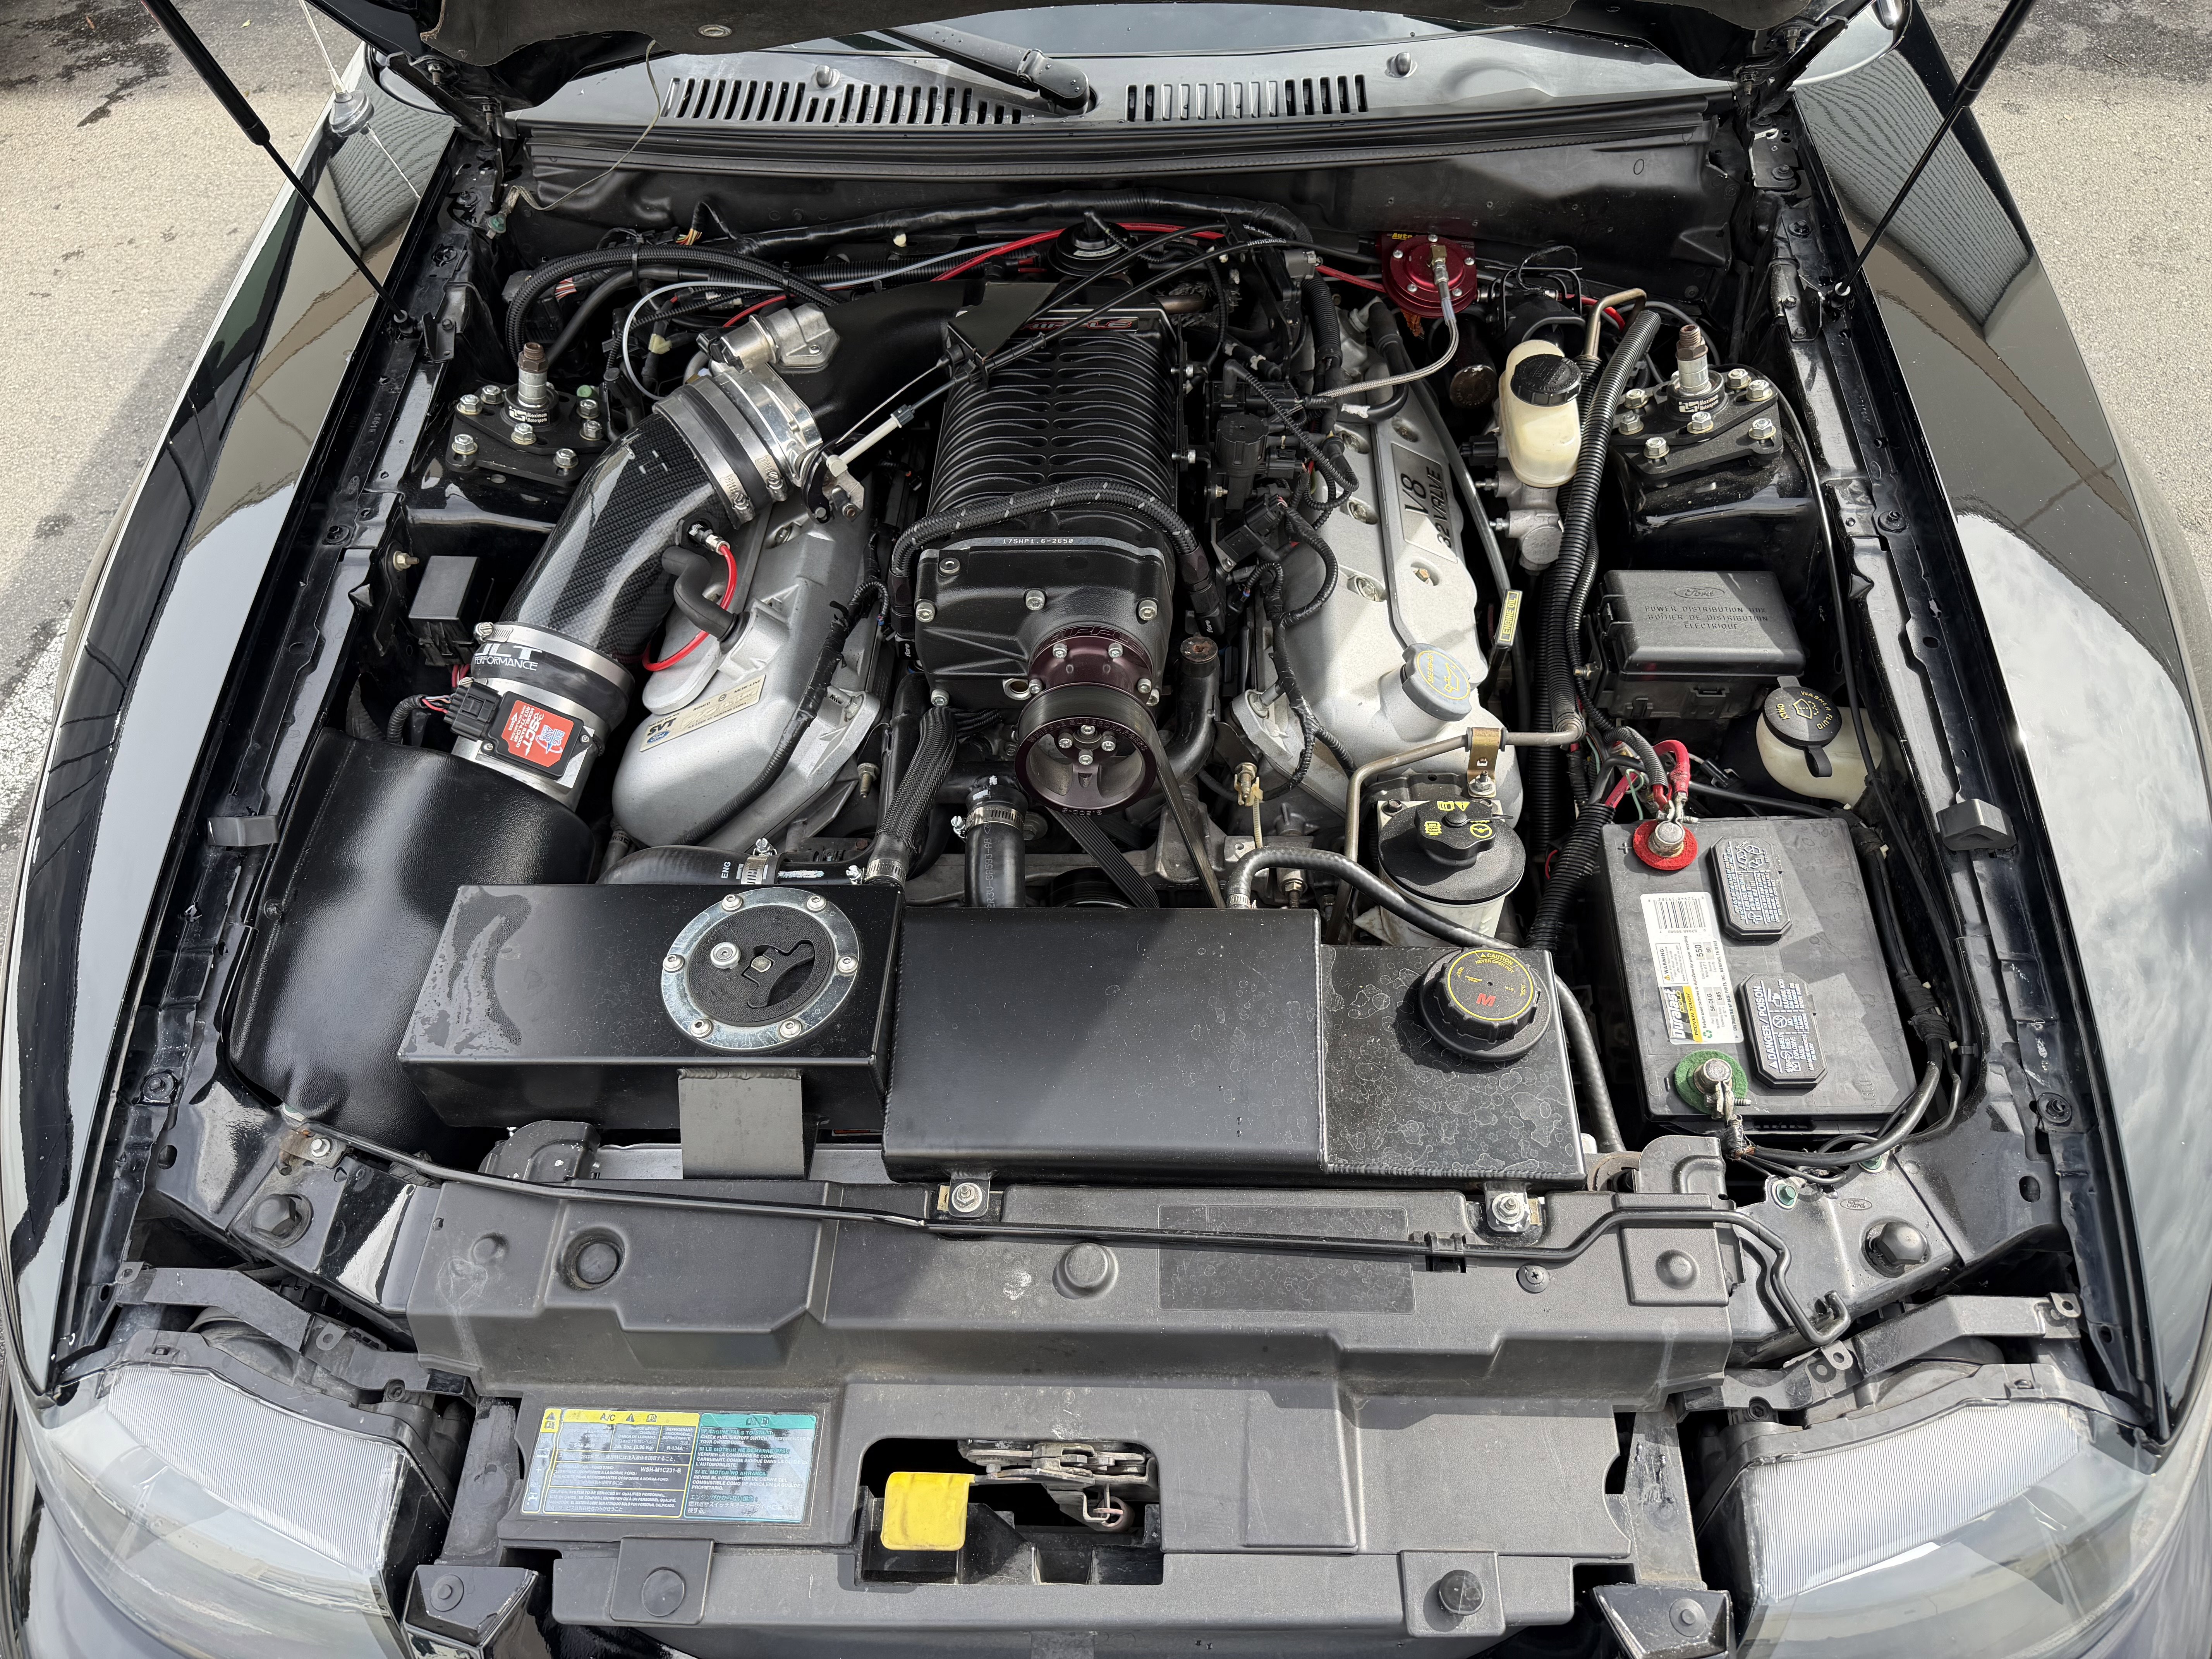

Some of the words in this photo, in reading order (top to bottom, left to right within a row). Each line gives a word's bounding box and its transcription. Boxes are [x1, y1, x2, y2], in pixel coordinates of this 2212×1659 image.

[1400, 473, 1429, 515] V8
[1426, 467, 1448, 522] VALVE
[1435, 522, 1452, 548] 32
[1685, 588, 1714, 596] Ford
[1508, 598, 1516, 608] OIL
[1503, 609, 1514, 634] ENGINE
[475, 643, 543, 660] JLT
[474, 656, 538, 671] PERFORMANCE
[1428, 668, 1436, 684] SAE
[1777, 703, 1790, 719] ONLY
[1801, 691, 1831, 711] WASHER
[514, 706, 530, 742] 407.774.CHIP
[647, 718, 677, 736] SVT
[1817, 713, 1832, 729] FLUID
[516, 727, 527, 748] BA3000
[522, 720, 539, 747] SCT
[541, 726, 553, 742] AIR
[552, 730, 565, 746] BIG
[1027, 721, 1066, 743] WHIPPLE
[1069, 719, 1148, 751] SUPERCHARGERS
[721, 861, 731, 879] ENG
[1683, 936, 1692, 951] recycling
[1694, 945, 1704, 957] 550
[1487, 953, 1513, 965] CAUTION
[1660, 947, 1669, 974] WARNING:
[1476, 993, 1496, 1007] M
[1675, 990, 1686, 1013] GOLD
[1753, 986, 1767, 1017] POISON
[1781, 989, 1790, 1009] SULFURIC
[1663, 988, 1685, 1038] Duralast
[1729, 1008, 1738, 1031] DISTRIBUTED
[1691, 1013, 1699, 1036] PROVEN
[1761, 1025, 1777, 1060] DANGER
[1777, 1034, 1786, 1049] SHIELD
[1790, 1036, 1800, 1060] EXPLOSIVE
[600, 1413, 616, 1422] A/C
